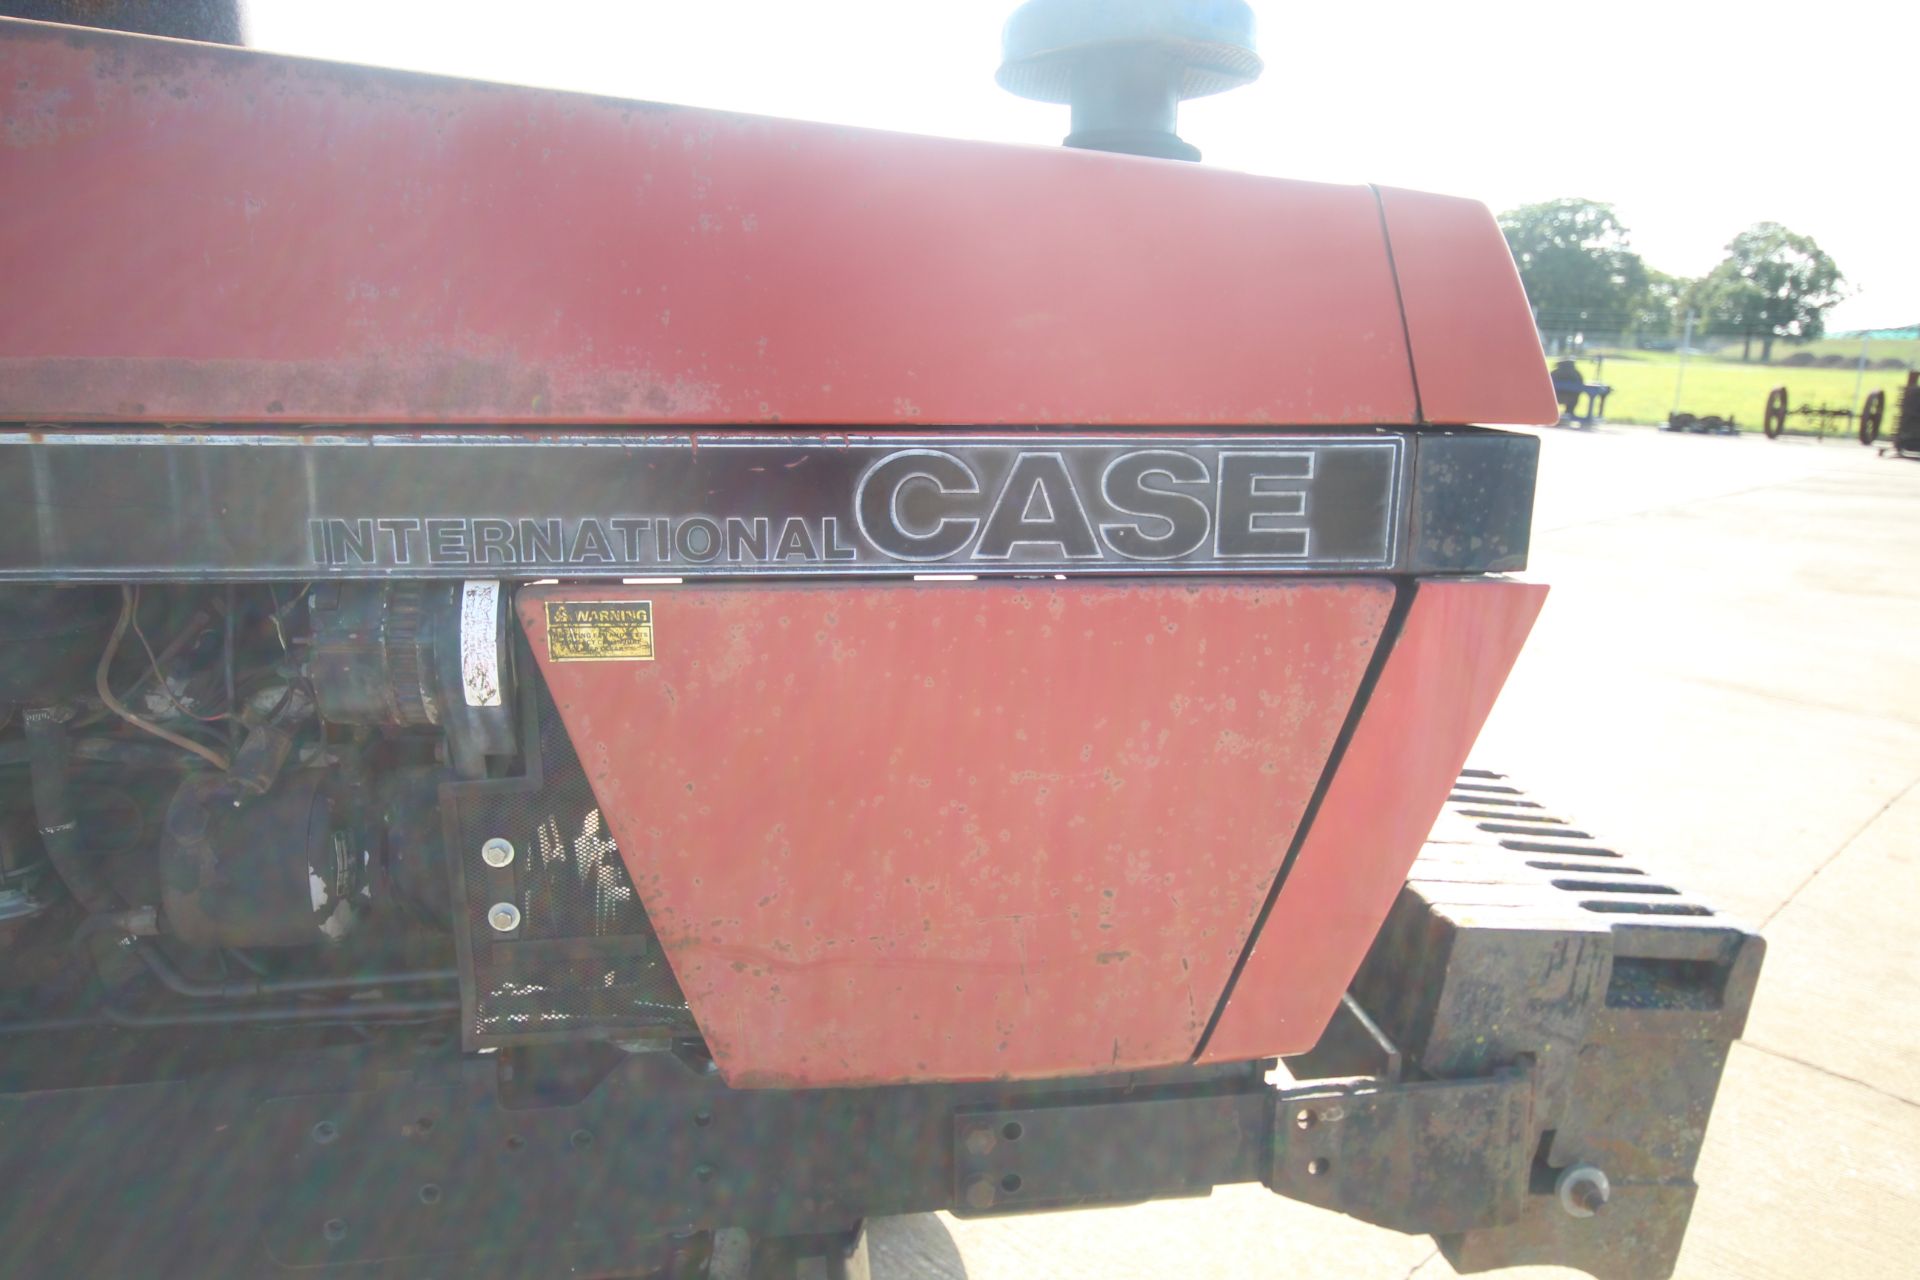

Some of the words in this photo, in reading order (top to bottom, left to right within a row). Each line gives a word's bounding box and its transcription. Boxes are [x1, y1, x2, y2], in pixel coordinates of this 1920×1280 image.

[310, 517, 857, 565] INTERNATIONAL
[854, 448, 1315, 561] CASE
[576, 609, 648, 622] WARNING
